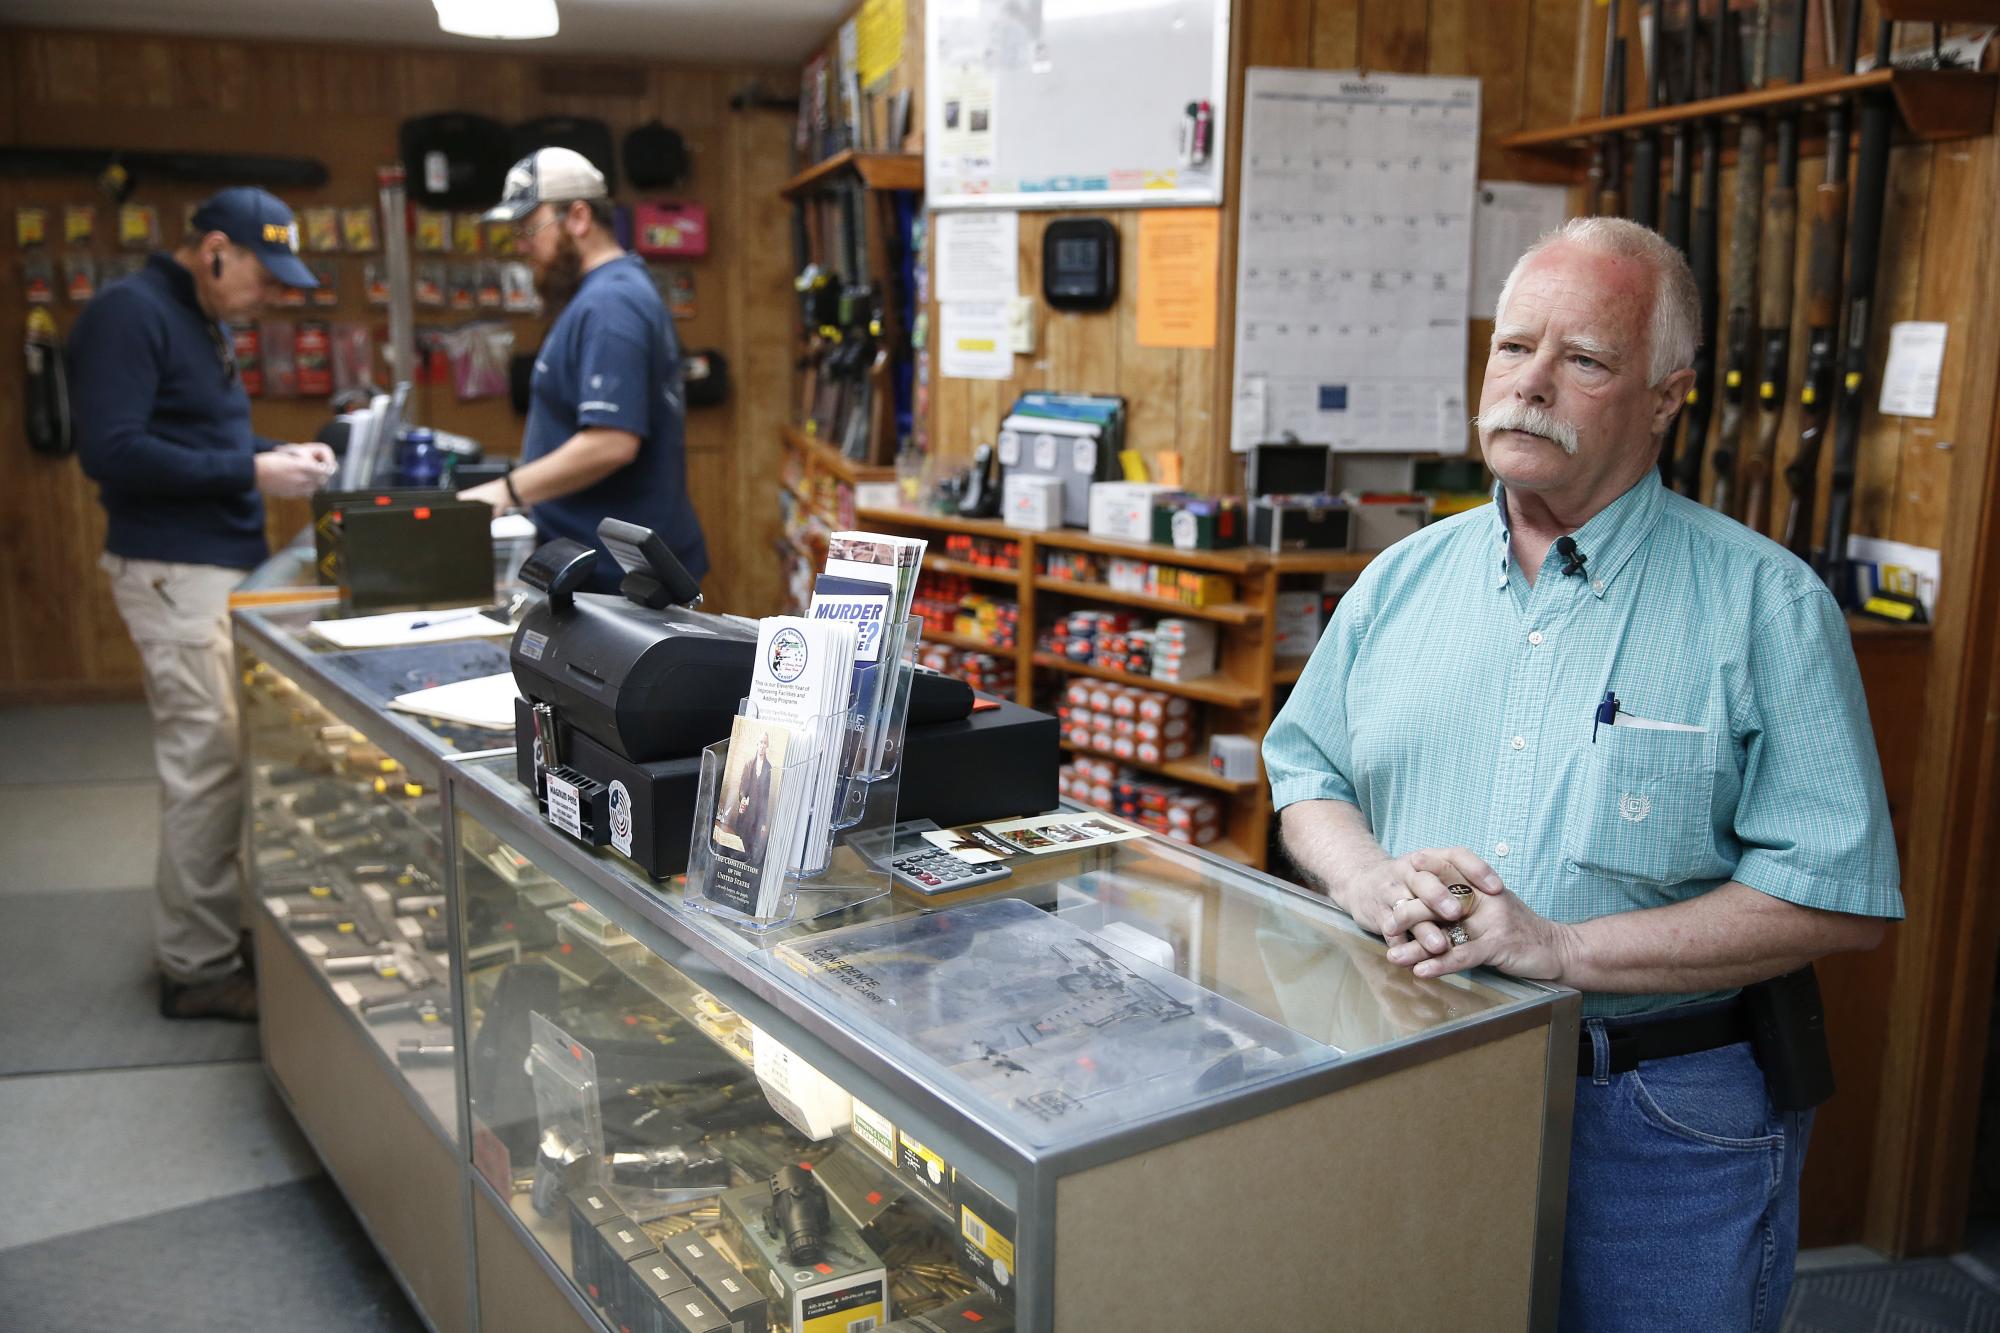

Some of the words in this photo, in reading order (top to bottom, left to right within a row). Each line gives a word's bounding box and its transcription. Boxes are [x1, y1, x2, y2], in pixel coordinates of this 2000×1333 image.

[814, 603, 883, 620] MURDER
[724, 858, 760, 875] CONSTITUTION
[717, 871, 734, 883] UNITED
[733, 877, 750, 889] STATES
[836, 973, 858, 986] YOU
